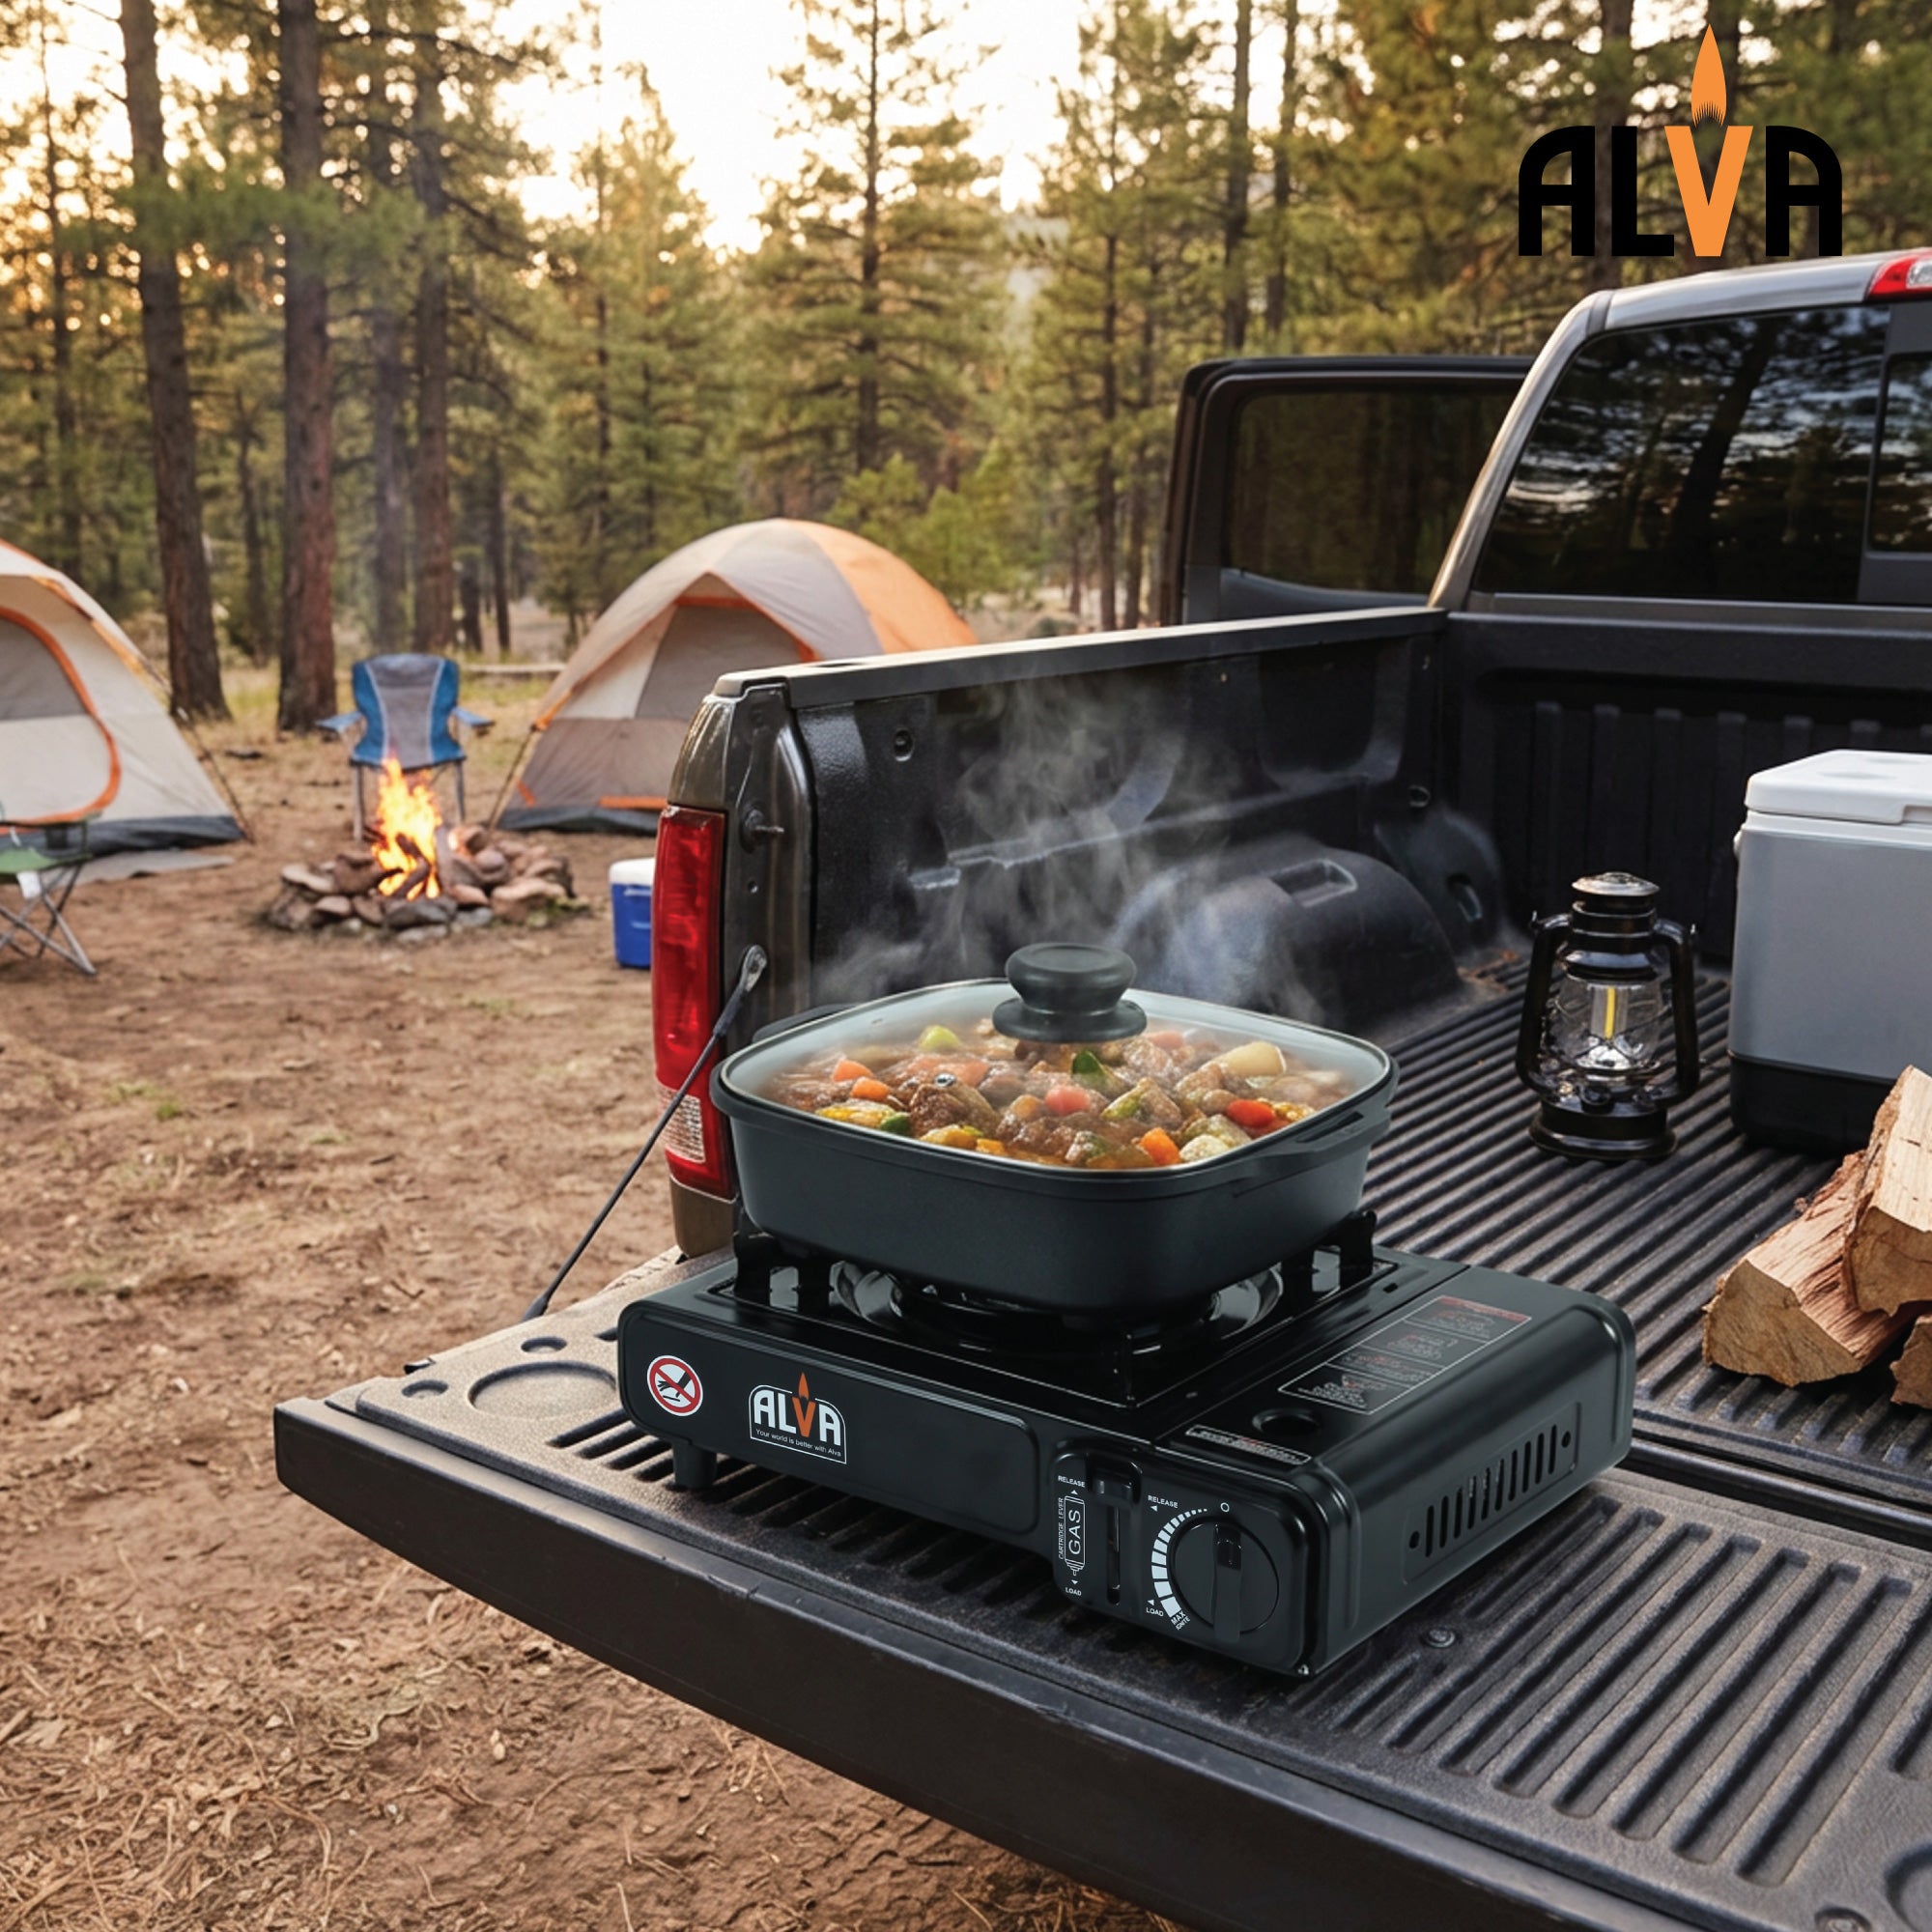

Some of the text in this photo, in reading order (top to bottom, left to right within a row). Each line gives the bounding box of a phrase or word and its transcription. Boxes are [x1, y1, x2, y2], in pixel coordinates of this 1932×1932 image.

[753, 1389, 841, 1446] ALVA
[756, 1429, 769, 1437] Your
[772, 1432, 787, 1442] world
[795, 1438, 812, 1449] better
[814, 1443, 827, 1453] with
[828, 1448, 841, 1457] Alva
[1058, 1475, 1086, 1488] RELEASE
[1148, 1494, 1179, 1509] RELEASE
[1068, 1509, 1081, 1554] GAS
[1065, 1587, 1081, 1596] LOAD
[1146, 1607, 1164, 1617] LOAD
[1171, 1610, 1186, 1625] MAX
